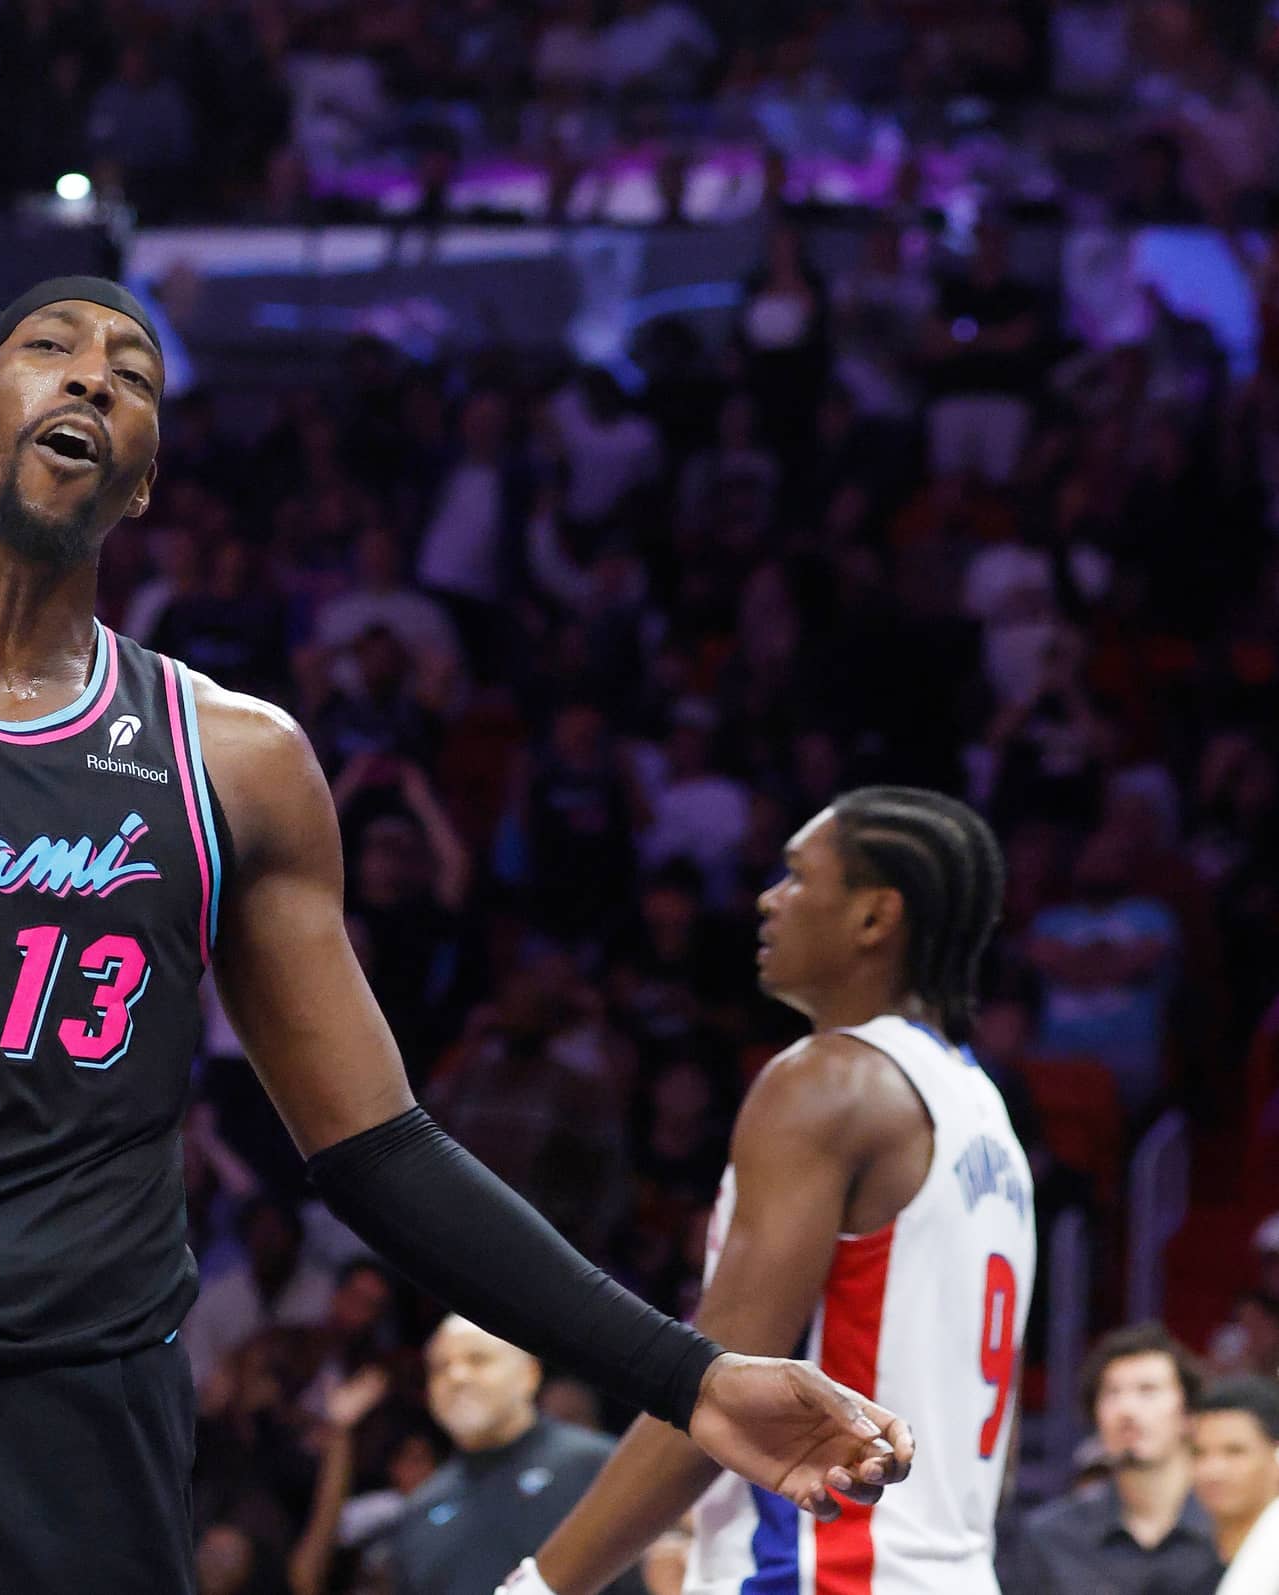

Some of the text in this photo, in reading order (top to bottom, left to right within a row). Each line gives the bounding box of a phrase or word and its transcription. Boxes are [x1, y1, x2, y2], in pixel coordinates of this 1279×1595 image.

[86, 754, 169, 784] Robinhood
[0, 925, 152, 1071] 13
[977, 1252, 1016, 1460] 9
